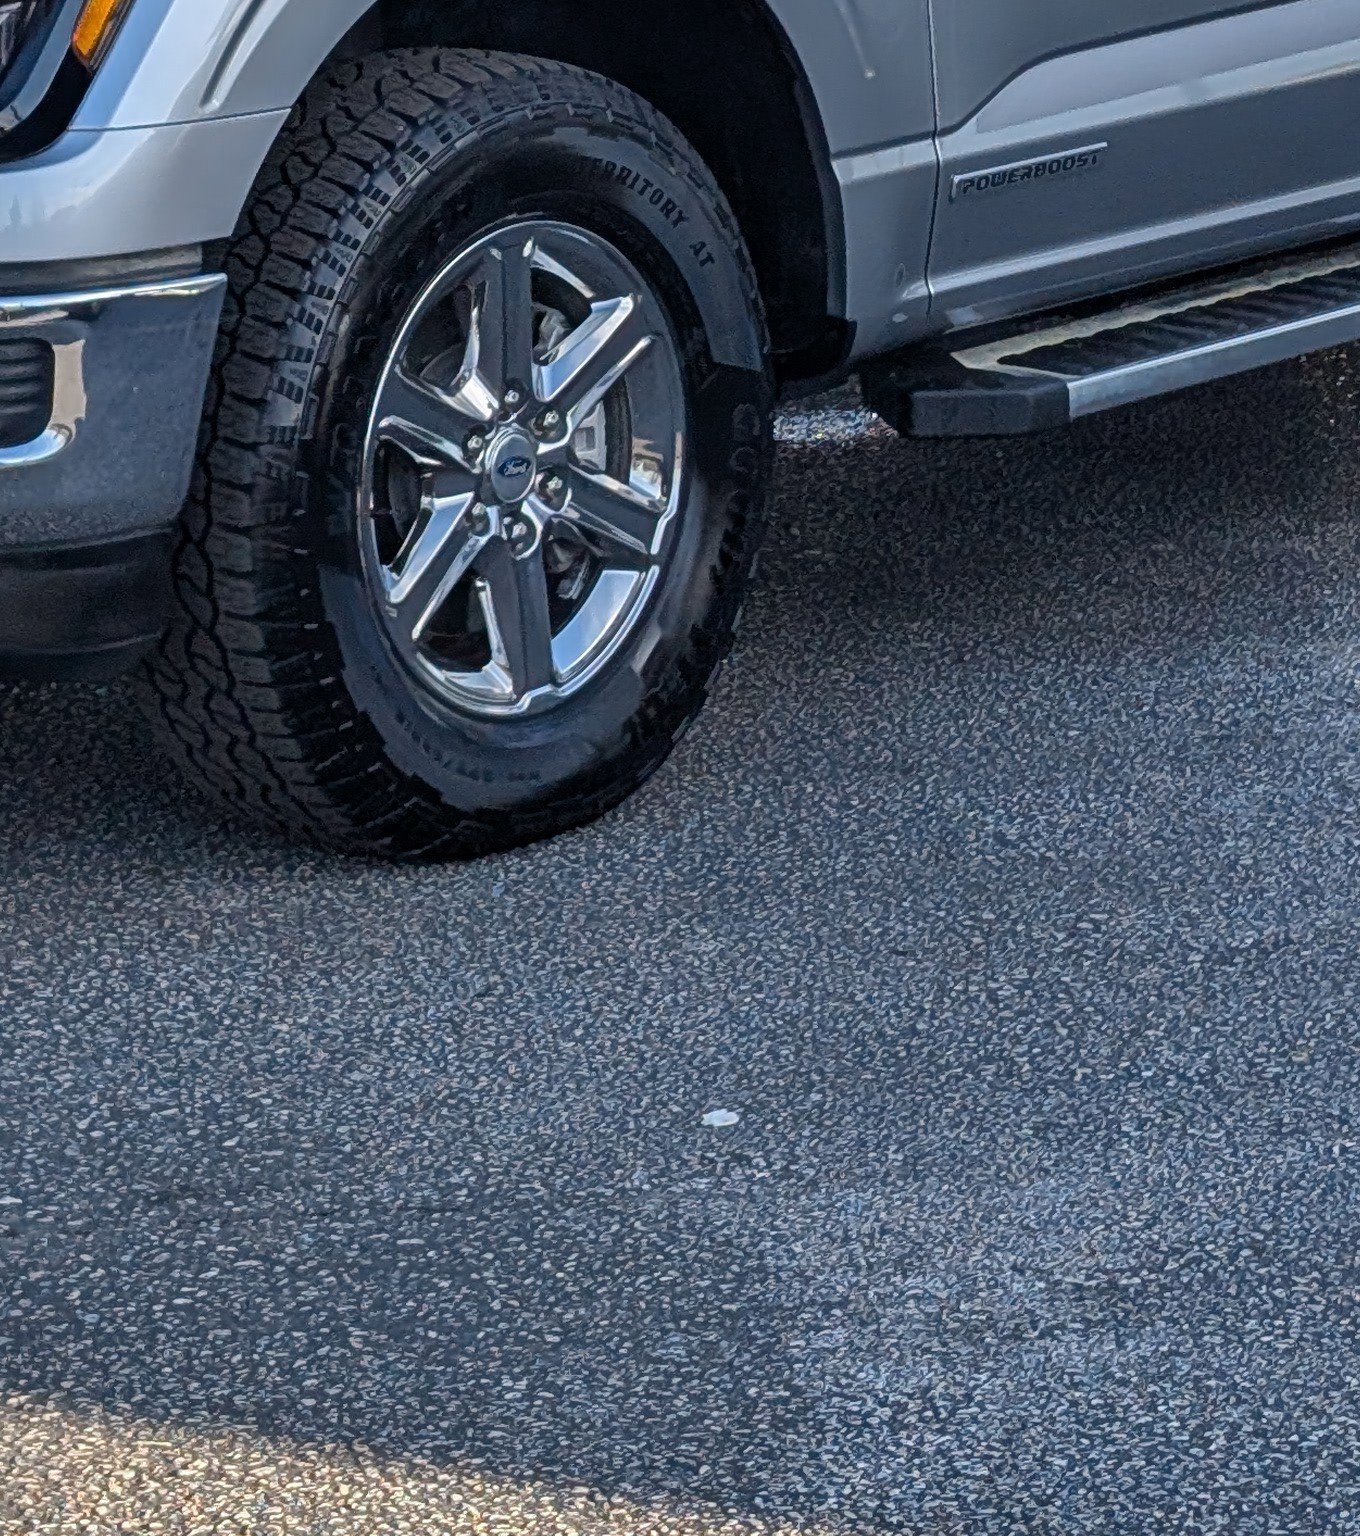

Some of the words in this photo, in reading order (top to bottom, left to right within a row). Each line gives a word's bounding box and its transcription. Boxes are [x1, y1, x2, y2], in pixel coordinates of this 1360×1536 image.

[961, 150, 1103, 195] POWERBOOST
[582, 156, 690, 230] RRITORY
[689, 240, 716, 268] AT
